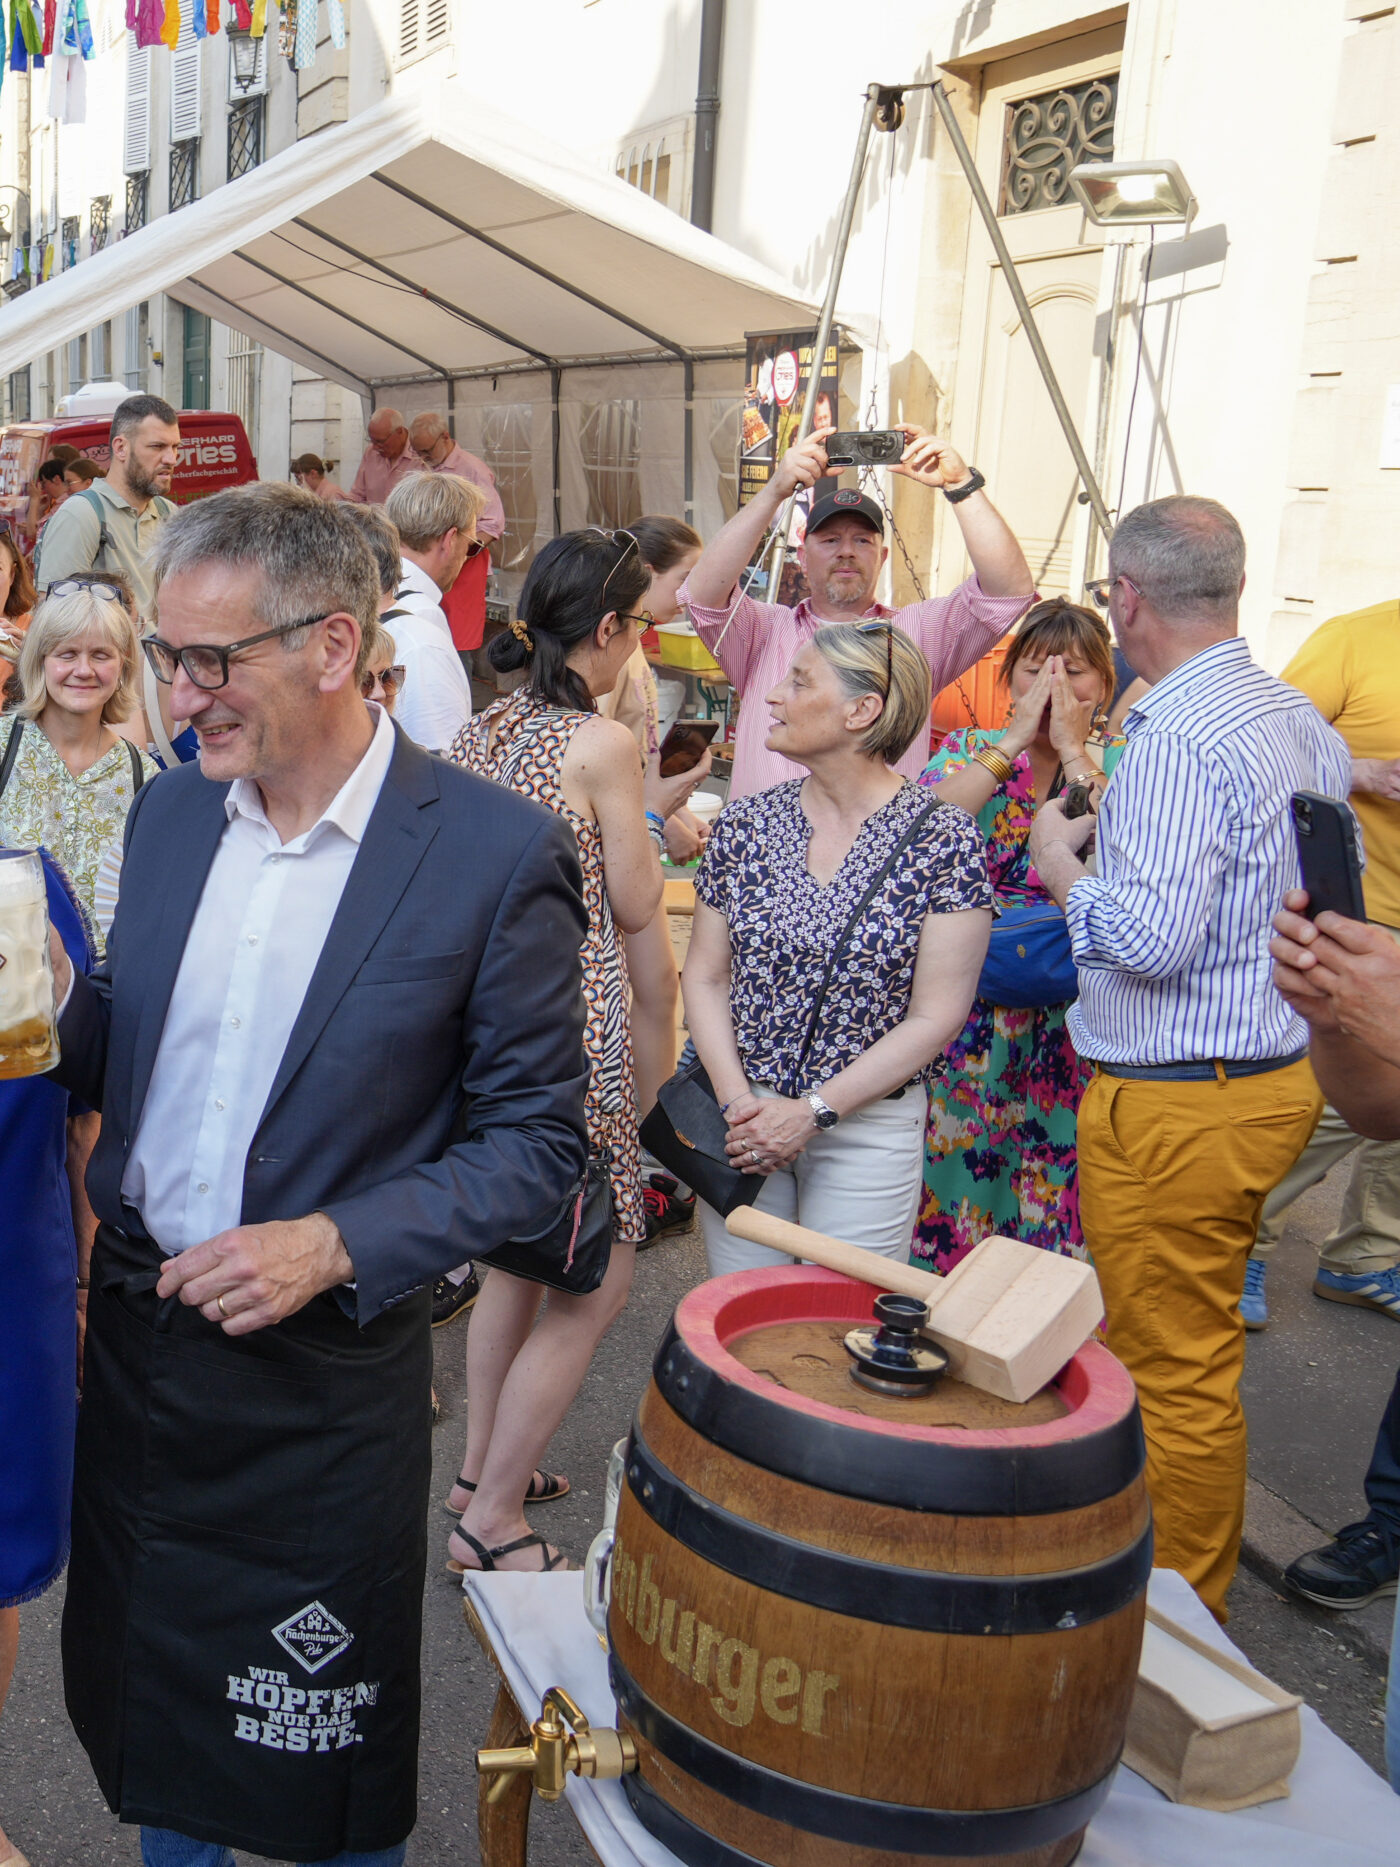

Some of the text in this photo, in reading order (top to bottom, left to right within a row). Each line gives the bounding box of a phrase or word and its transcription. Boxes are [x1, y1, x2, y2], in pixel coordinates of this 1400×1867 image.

[180, 434, 236, 447] ERHARD
[172, 467, 238, 479] scherfachgeschäft
[248, 1665, 290, 1686] WIR
[226, 1675, 380, 1714] HOPFEN
[268, 1710, 352, 1728] NUR DAS
[234, 1713, 364, 1752] BESTE.
